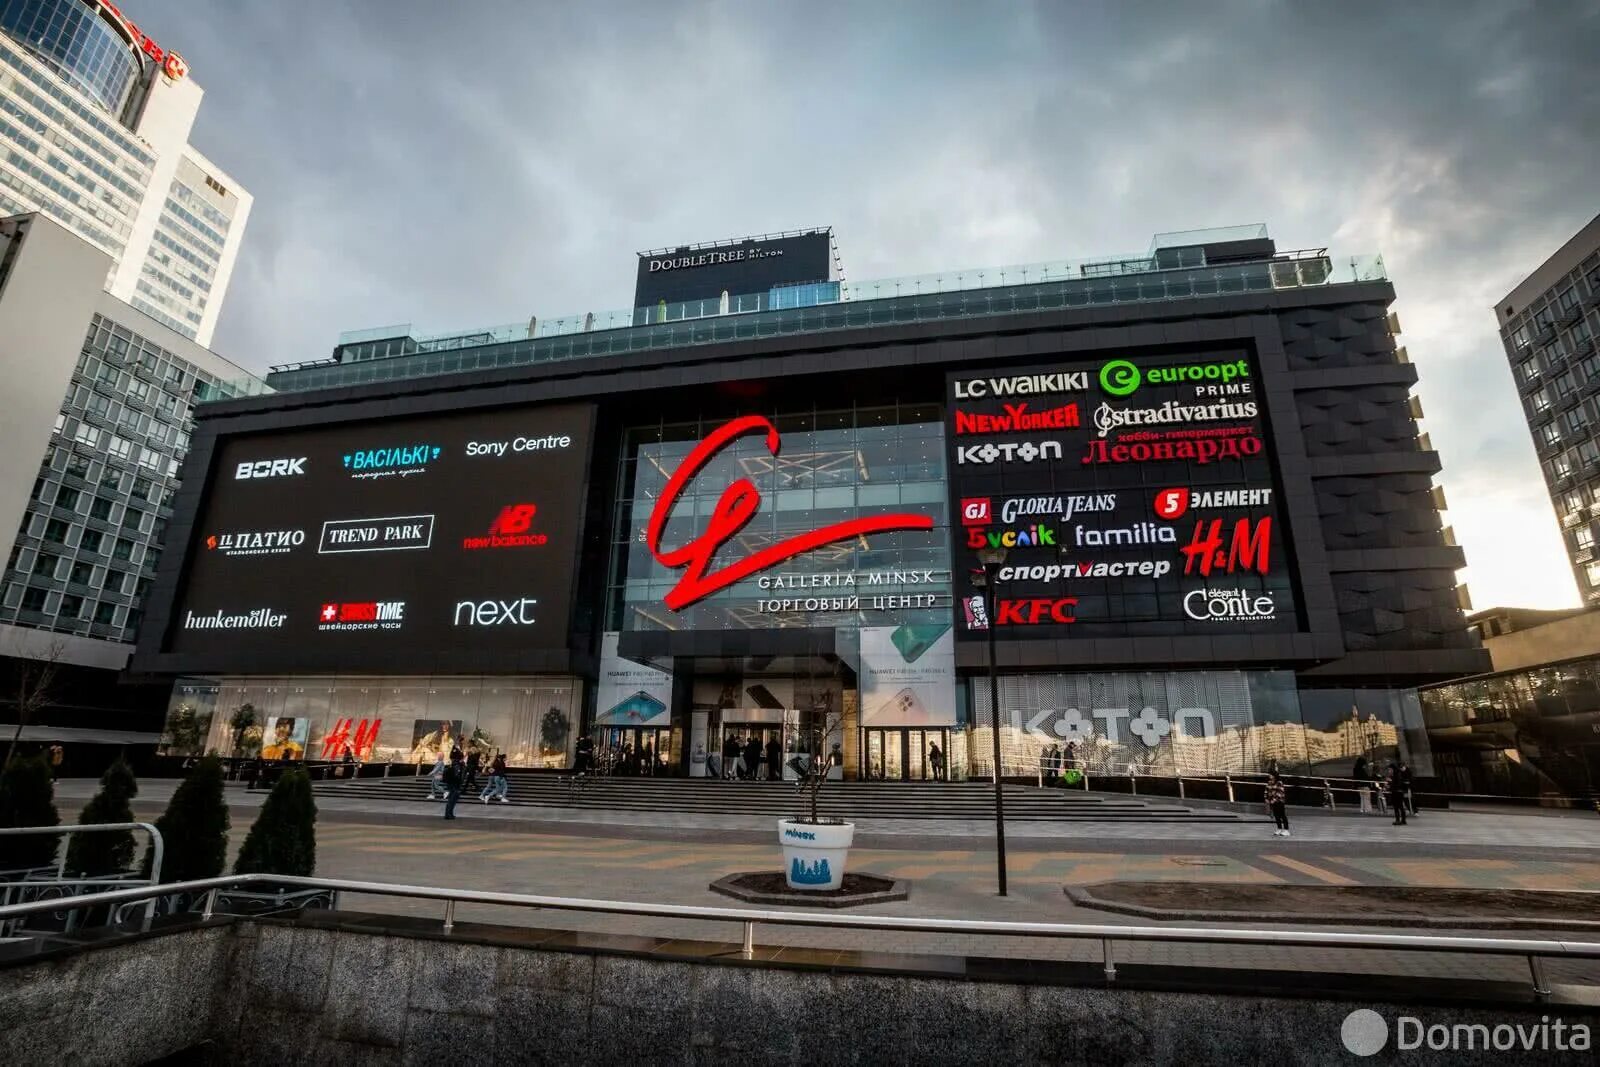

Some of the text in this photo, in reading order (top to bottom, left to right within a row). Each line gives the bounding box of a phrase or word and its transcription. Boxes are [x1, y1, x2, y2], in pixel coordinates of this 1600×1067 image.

[649, 249, 745, 272] DOUBLETREE
[749, 250, 783, 259] HILTON
[1147, 359, 1249, 383] euroopt
[955, 379, 986, 398] LC
[1196, 383, 1251, 397] PRIME
[1110, 399, 1257, 427] stradivarius
[466, 433, 571, 458] Sony Centre
[1081, 437, 1262, 464] Леонардо
[235, 456, 308, 480] BORK
[1001, 493, 1117, 523] GLORIA JEANS
[1163, 488, 1272, 514] 5 ЭЛЕМЕНТ
[234, 530, 305, 549] ПАТИО
[329, 523, 423, 545] TREND PARK
[463, 533, 548, 550] new balance
[1076, 522, 1176, 546] familia
[1180, 516, 1273, 577] H&M
[758, 570, 934, 589] GALLERIA MINSK
[999, 559, 1170, 583] спортмастер
[454, 597, 538, 626] next
[758, 594, 936, 612] ТОРГОВЫЙ ЦЕНТР
[995, 597, 1079, 625] KFC
[1183, 588, 1275, 620] Conte
[184, 608, 288, 629] hunkemöller
